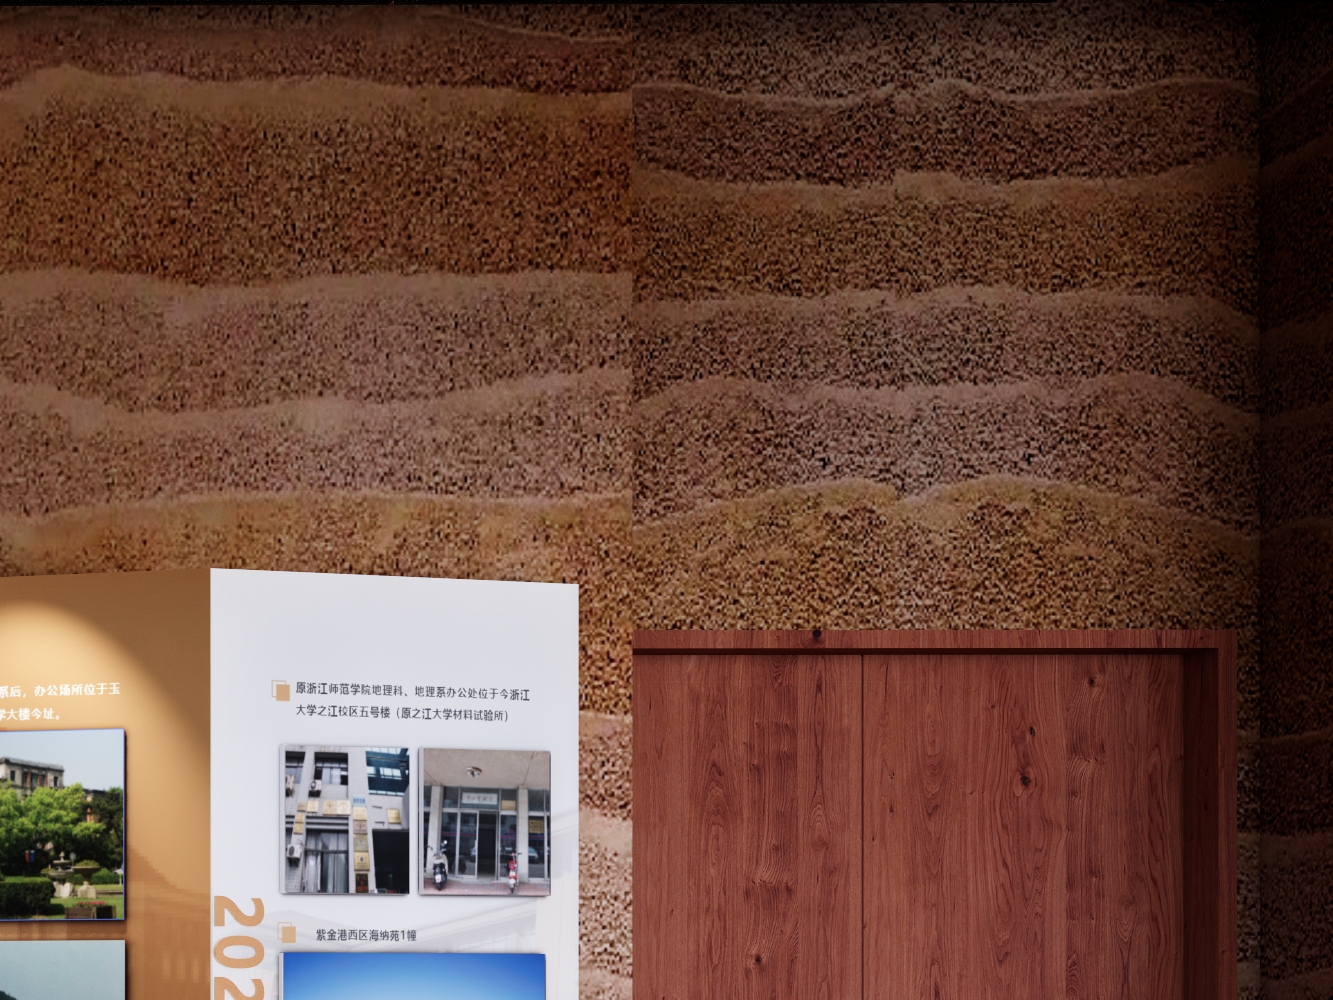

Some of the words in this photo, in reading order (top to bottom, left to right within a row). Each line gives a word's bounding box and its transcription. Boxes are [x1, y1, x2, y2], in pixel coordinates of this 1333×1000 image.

[295, 681, 531, 701] 原浙江师范学院地理科、地理系办公处位于今浙江
[295, 704, 509, 722] 大学之江校区五号楼（原之江大学材料试验所）
